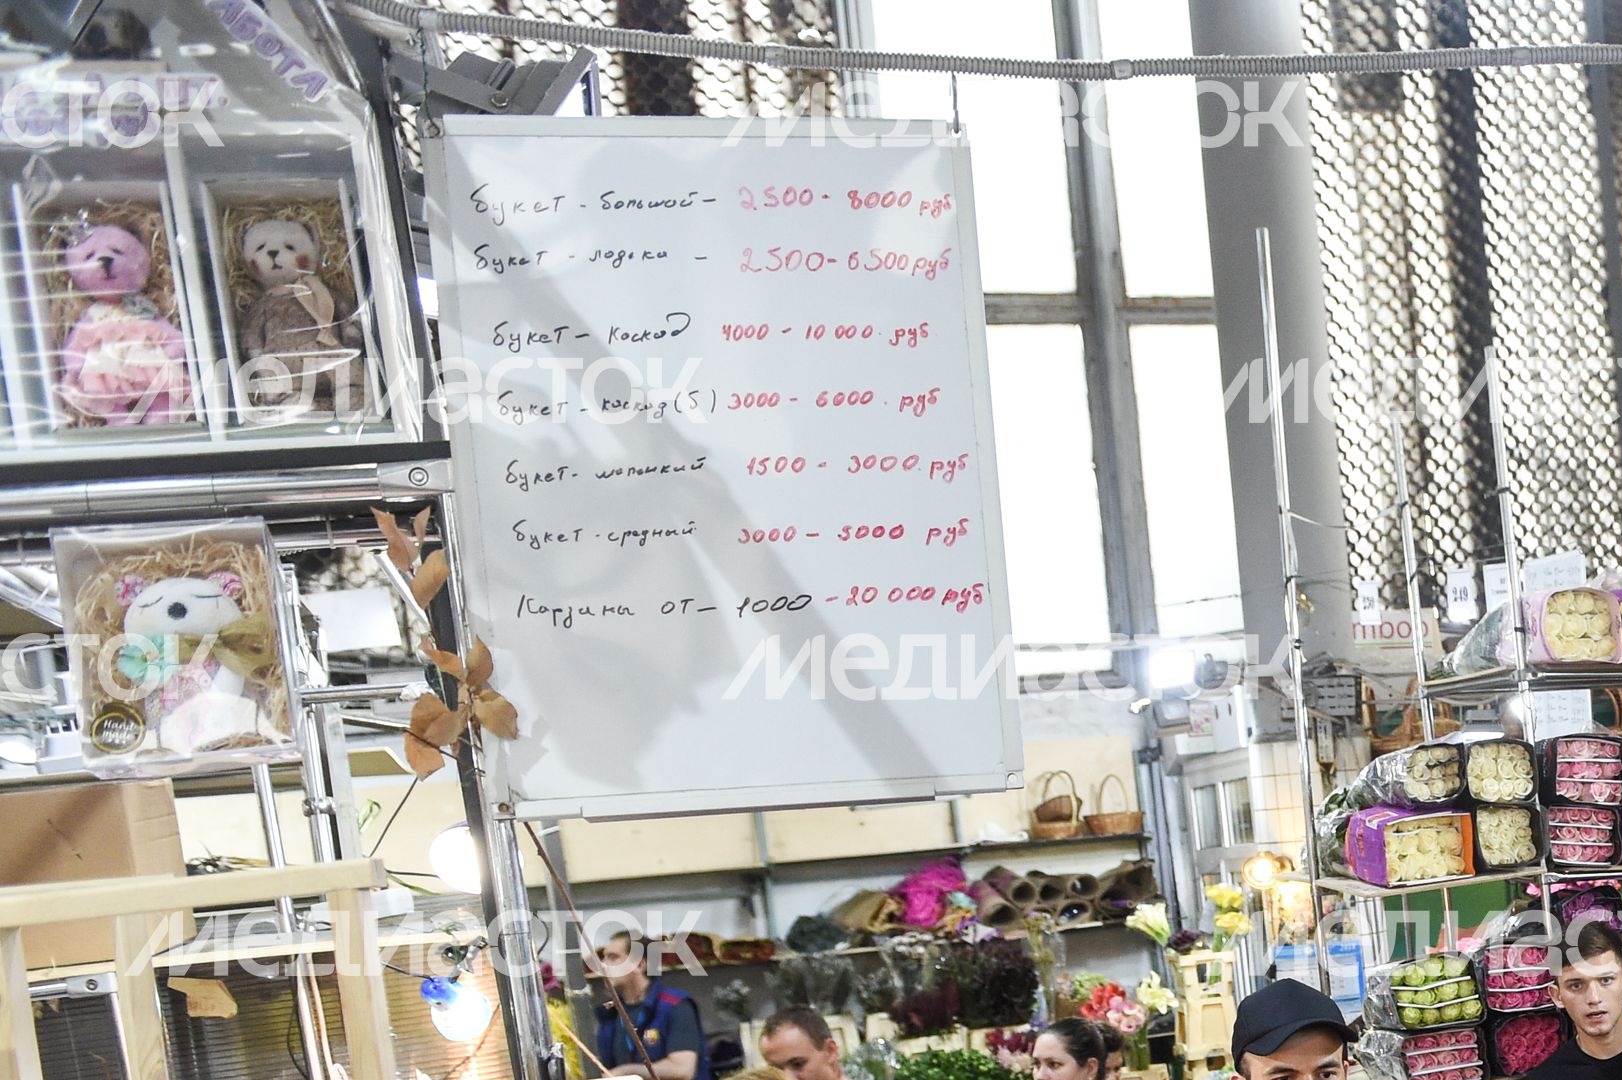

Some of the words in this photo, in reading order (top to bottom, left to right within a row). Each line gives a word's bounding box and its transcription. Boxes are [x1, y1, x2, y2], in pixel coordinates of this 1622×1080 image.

[470, 184, 565, 225] букет
[847, 190, 912, 209] 8000
[474, 244, 548, 273] букет
[847, 247, 908, 271] 6500
[912, 248, 952, 281] руб
[493, 321, 570, 353] букет
[728, 393, 780, 410] 3000
[899, 387, 941, 417] руб
[505, 460, 568, 491] букет
[747, 456, 806, 475] 1500
[929, 453, 968, 484] руб
[513, 520, 583, 549] букет
[738, 526, 797, 544] 3000
[837, 524, 905, 541] 5000
[926, 518, 969, 546] руб
[737, 595, 812, 618] 1000
[941, 583, 985, 614] руб
